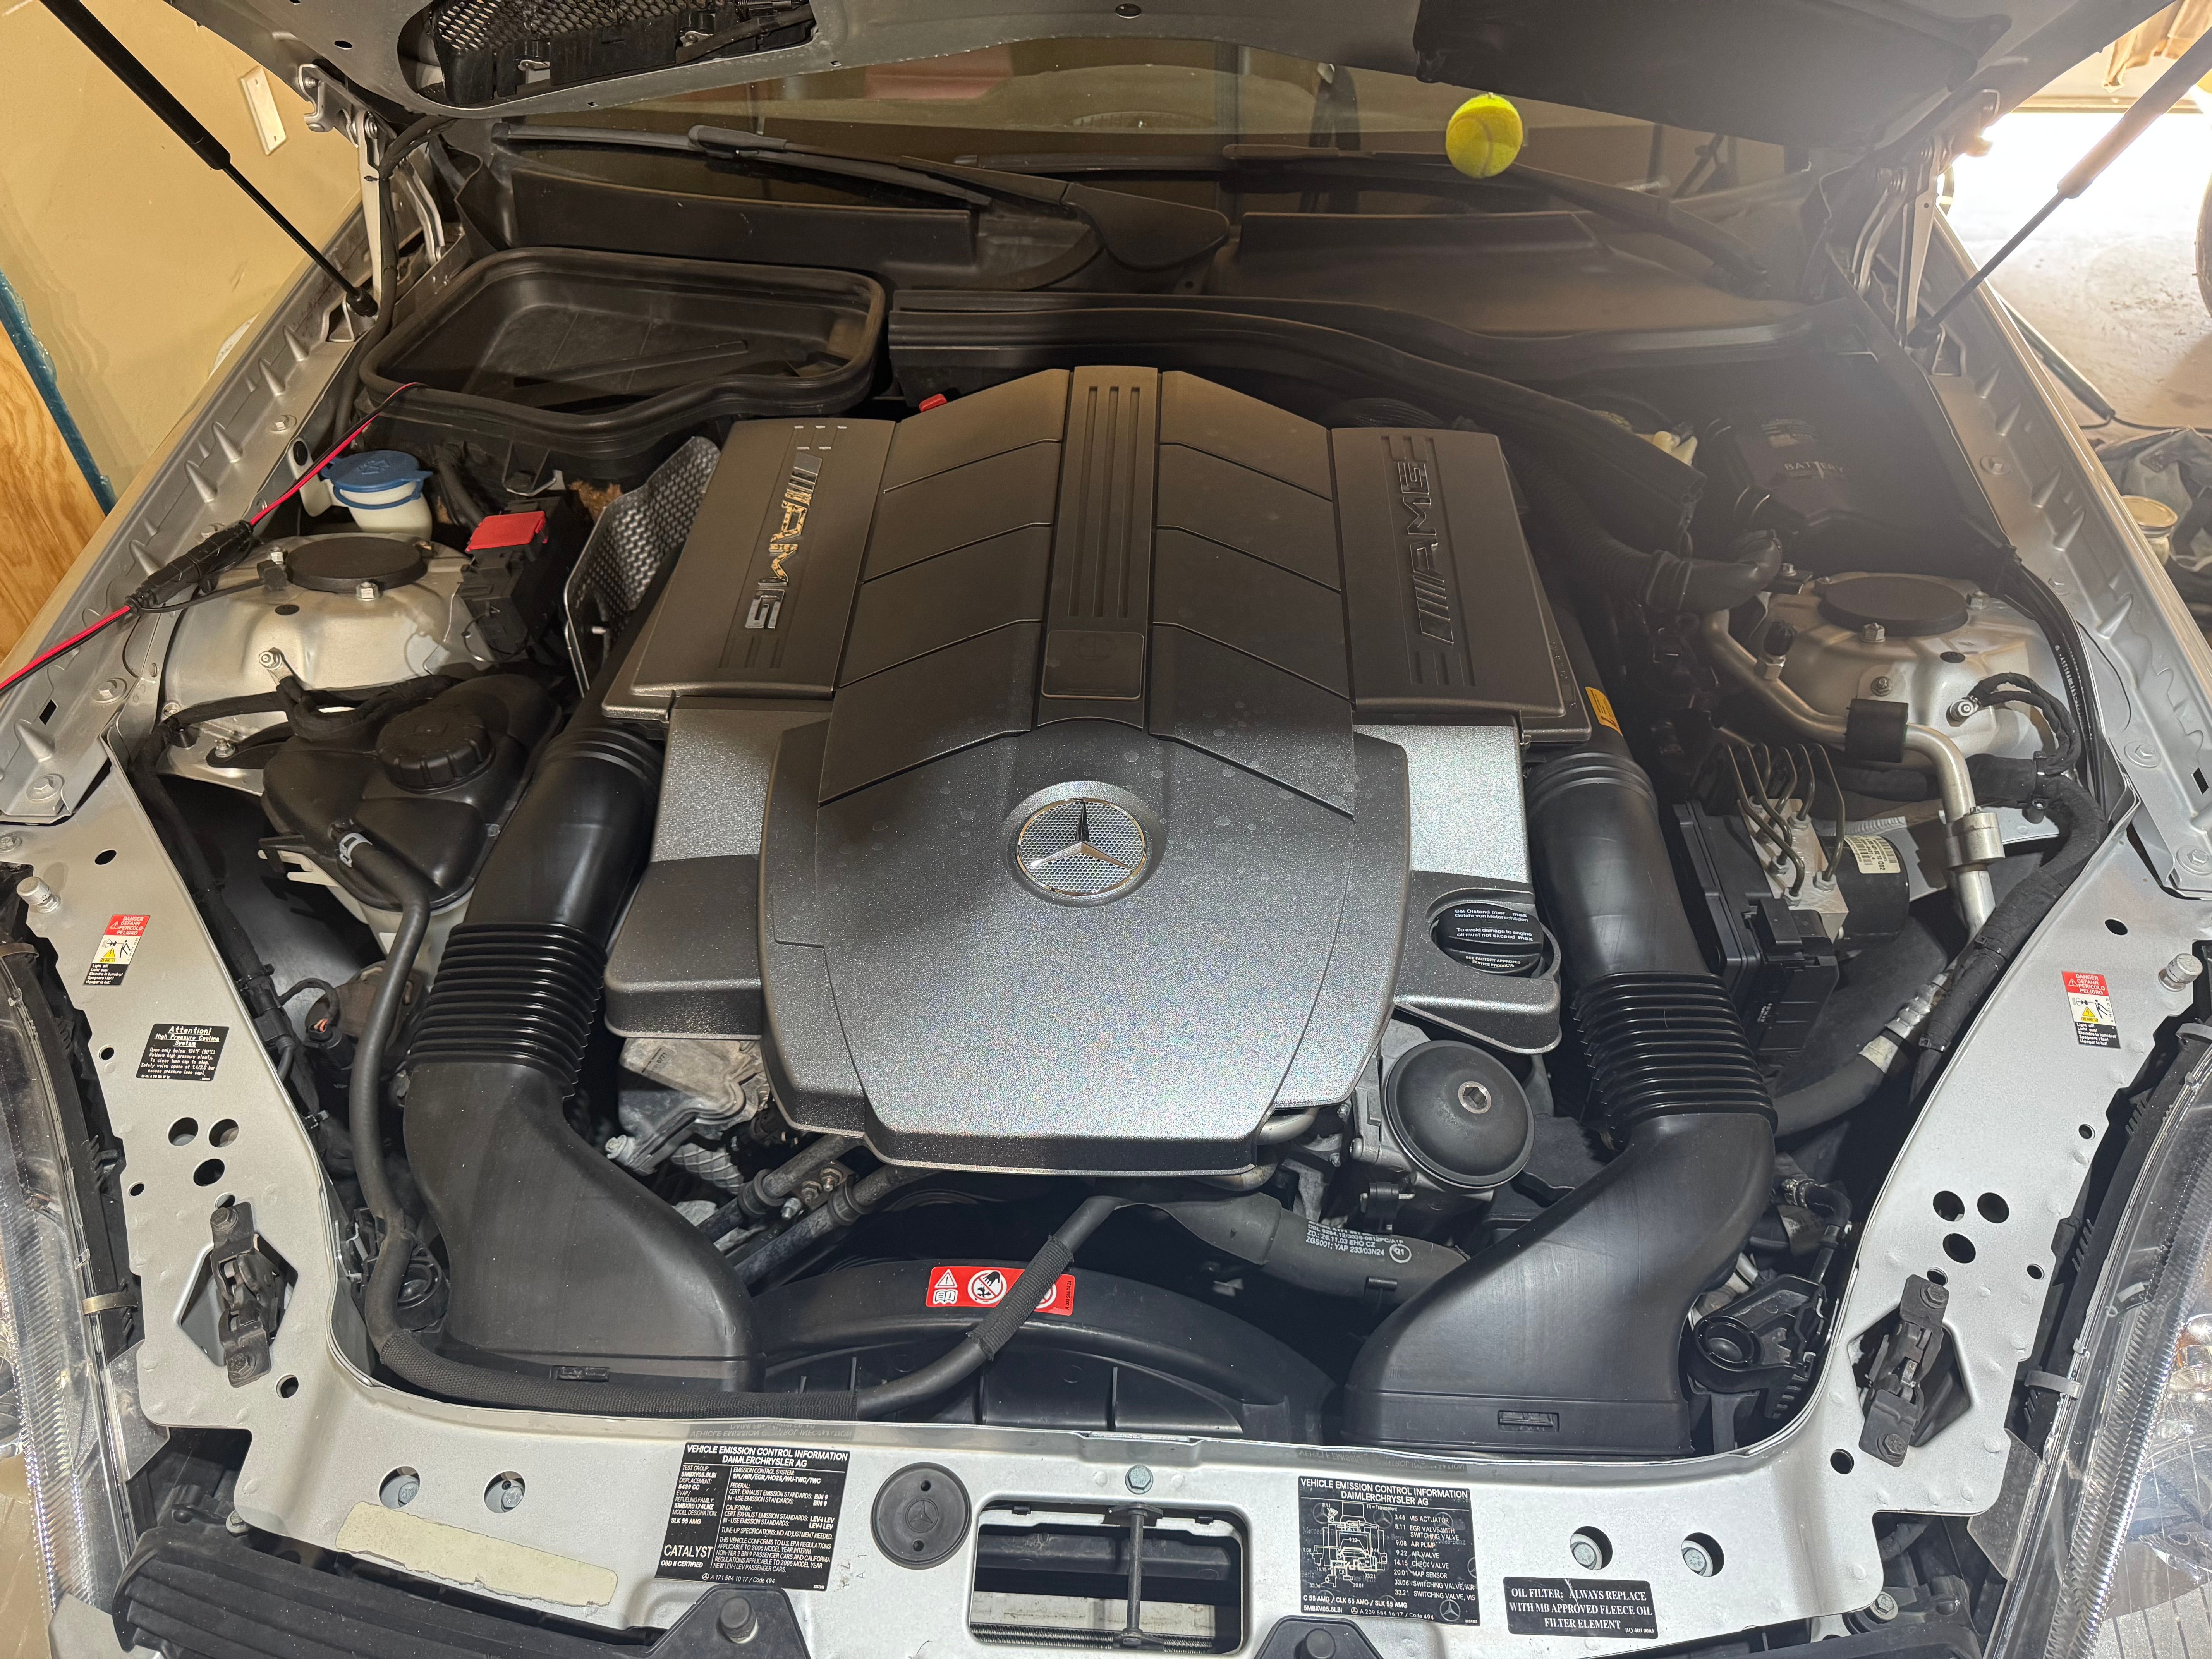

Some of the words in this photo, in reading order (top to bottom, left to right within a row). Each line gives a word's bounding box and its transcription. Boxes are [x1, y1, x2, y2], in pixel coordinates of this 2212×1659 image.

[1397, 461, 1445, 586] AMG
[687, 1444, 718, 1454] VEHICLE
[719, 1446, 756, 1455] EMISSION
[757, 1447, 793, 1457] CONTROL
[794, 1449, 848, 1461] INFORMATION
[722, 1455, 795, 1467] DAIMLERCHRYSLER
[795, 1459, 807, 1467] AG
[1300, 1478, 1333, 1489] VEHICLE
[1335, 1481, 1373, 1492] EMISSION
[1375, 1484, 1412, 1495] CONTROL
[1413, 1487, 1468, 1499] INFORMATION
[1341, 1490, 1415, 1505] DAIMLERCHRYSLER
[1417, 1497, 1429, 1506] AG
[1419, 1516, 1449, 1524] ACTUATOR
[1410, 1531, 1441, 1540] SWITCHING
[664, 1544, 714, 1558] CATALYST
[1413, 1580, 1443, 1589] SWITCHING
[1317, 1595, 1330, 1604] AMG
[1413, 1590, 1444, 1599] SWITCHING
[1511, 1588, 1528, 1597] OIL
[1529, 1589, 1563, 1599] FILTER:
[1569, 1589, 1604, 1599] ALWAYS
[1605, 1590, 1647, 1601] REPLACE
[1509, 1602, 1534, 1612] WITH
[1535, 1603, 1550, 1613] MB
[1551, 1604, 1598, 1614] APPROVED
[1599, 1605, 1635, 1615] FLEECE
[1636, 1606, 1653, 1615] OIL
[1544, 1618, 1577, 1628] FILTER
[1577, 1619, 1621, 1630] ELEMENT
